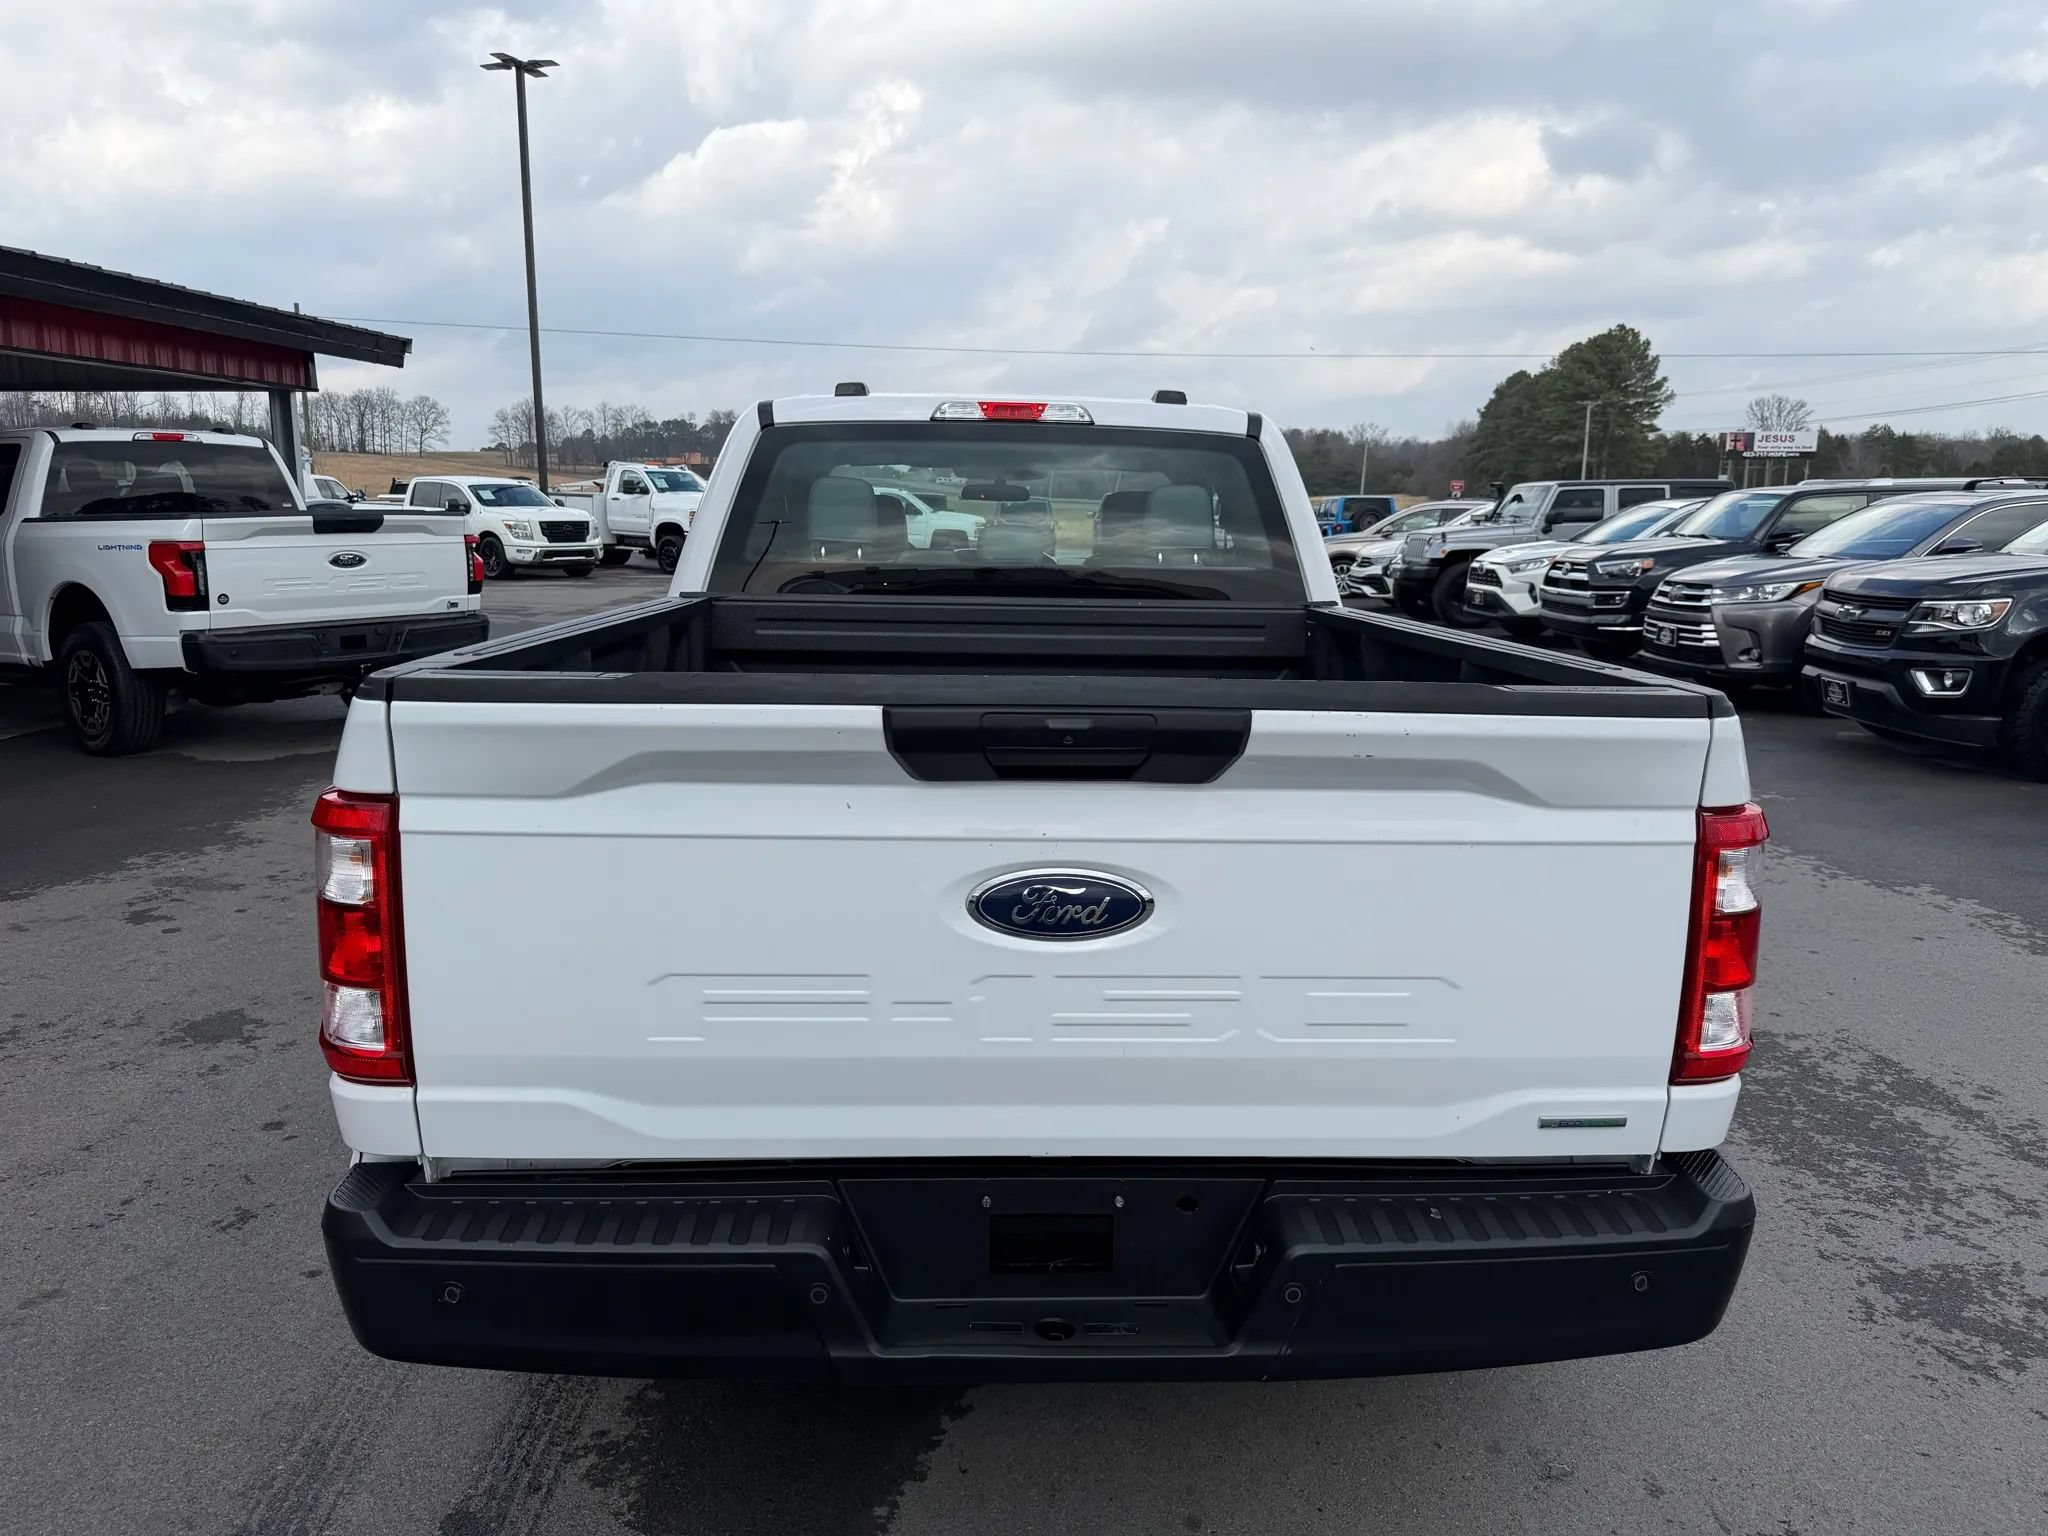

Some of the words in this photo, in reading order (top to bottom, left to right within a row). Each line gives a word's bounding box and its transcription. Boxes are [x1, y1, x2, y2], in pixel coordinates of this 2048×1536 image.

[1758, 434, 1795, 443] JESUS
[97, 544, 143, 552] LIGHTNING
[262, 571, 428, 596] F-150
[1011, 884, 1112, 925] Ford
[645, 973, 1463, 1043] F-150
